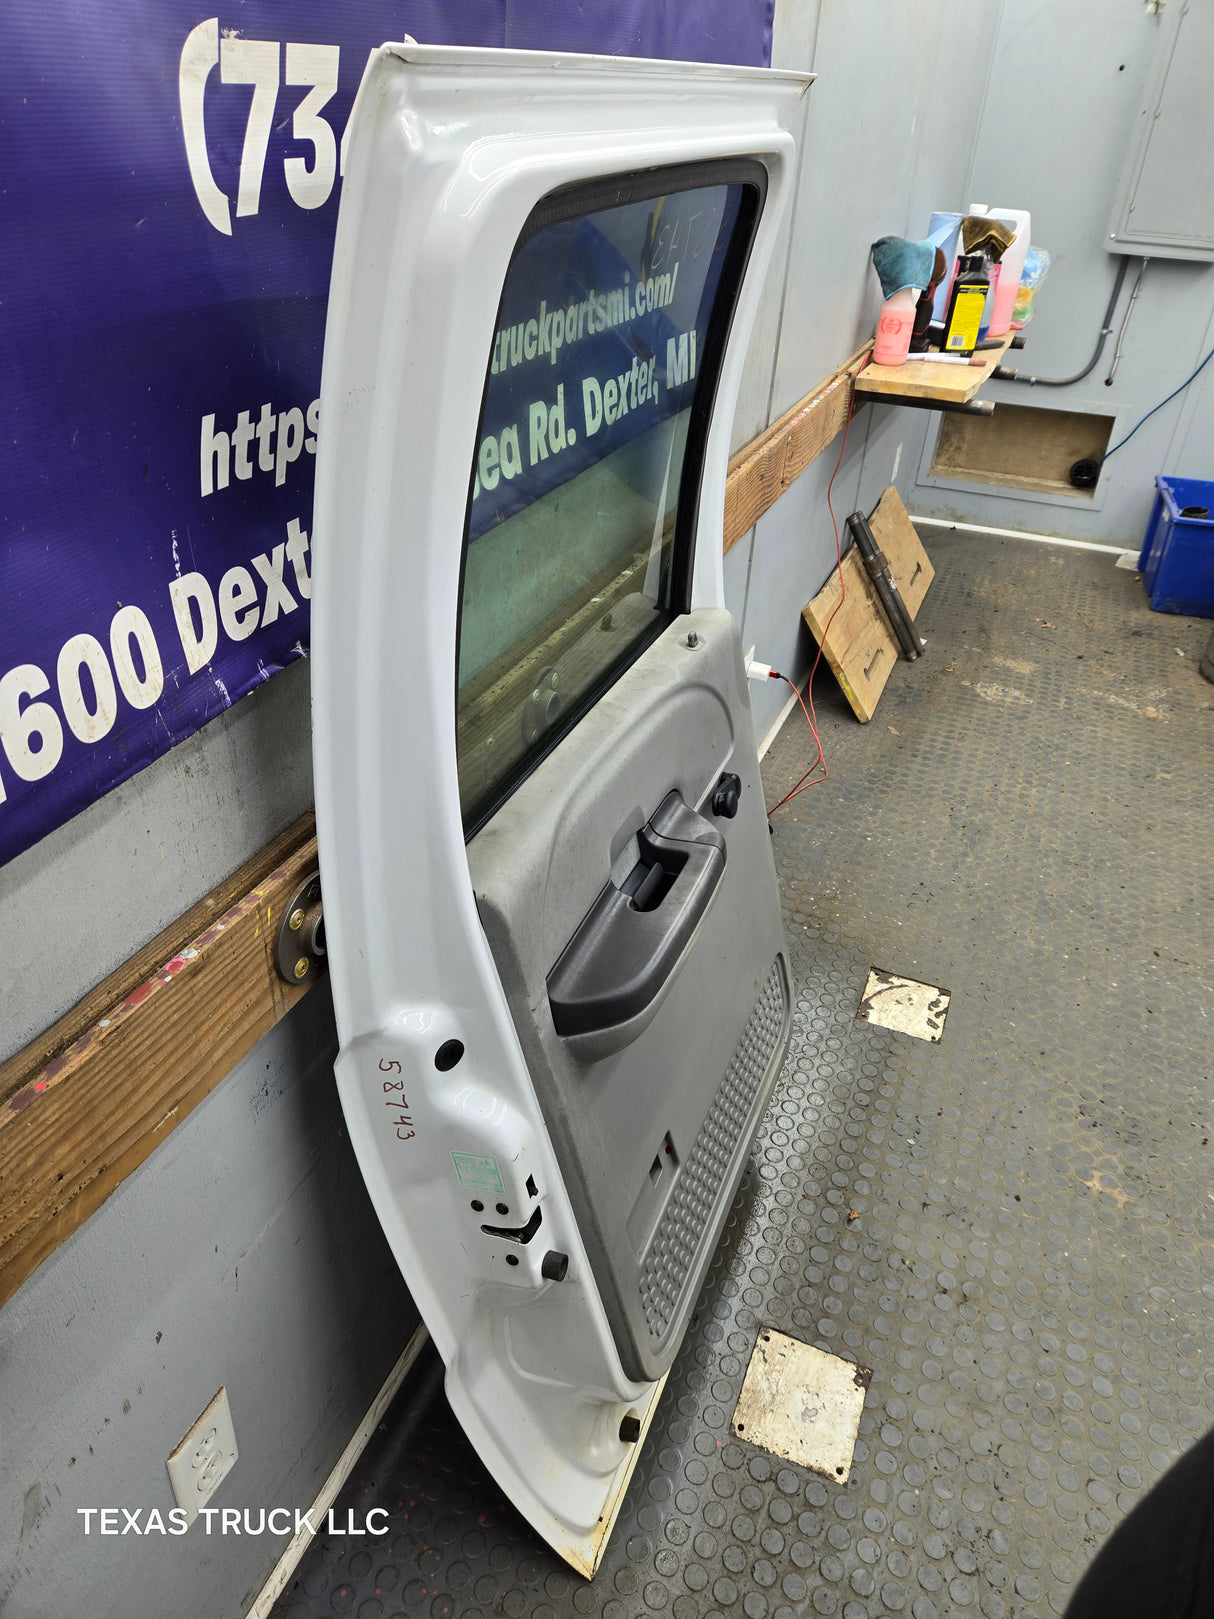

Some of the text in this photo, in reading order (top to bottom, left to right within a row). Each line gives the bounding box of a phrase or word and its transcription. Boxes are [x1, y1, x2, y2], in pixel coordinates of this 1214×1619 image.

[180, 17, 418, 236] (73
[0, 605, 164, 804] 600
[473, 424, 522, 500] ea
[529, 383, 576, 466] Rd.
[582, 355, 659, 437] Dexter,
[667, 330, 696, 390] MI
[379, 1057, 415, 1140] 58743
